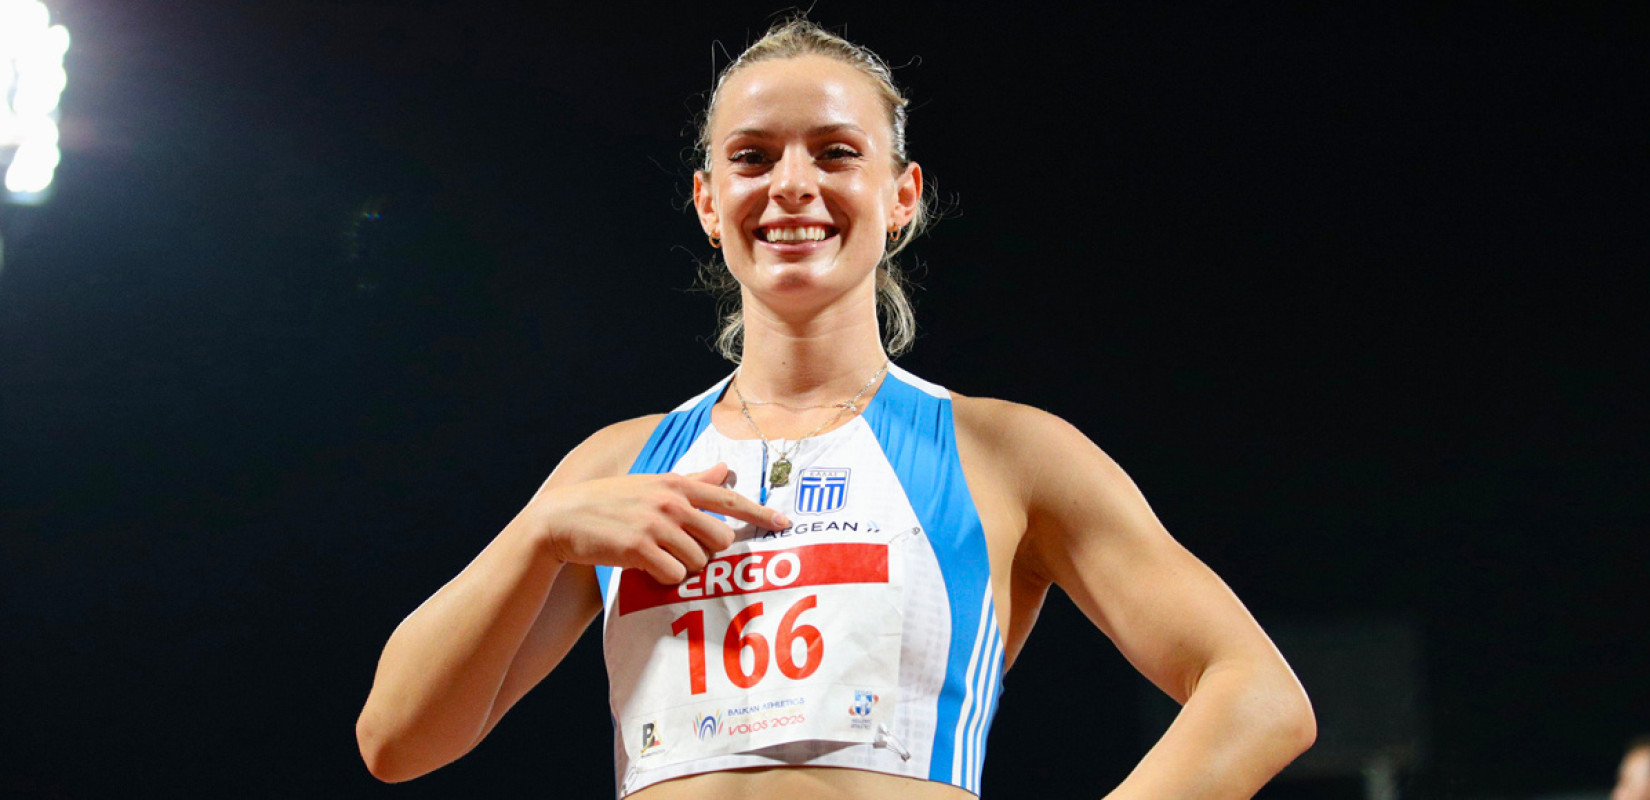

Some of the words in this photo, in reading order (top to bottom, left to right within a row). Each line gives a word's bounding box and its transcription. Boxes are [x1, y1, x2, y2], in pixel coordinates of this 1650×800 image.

[763, 521, 858, 539] AEGEAN
[678, 553, 801, 597] ERGO
[671, 595, 824, 695] 166
[728, 705, 760, 717] BALKAN
[762, 697, 805, 711] ATHLETICS
[728, 720, 768, 736] VOLOS
[771, 714, 807, 728] 2025
